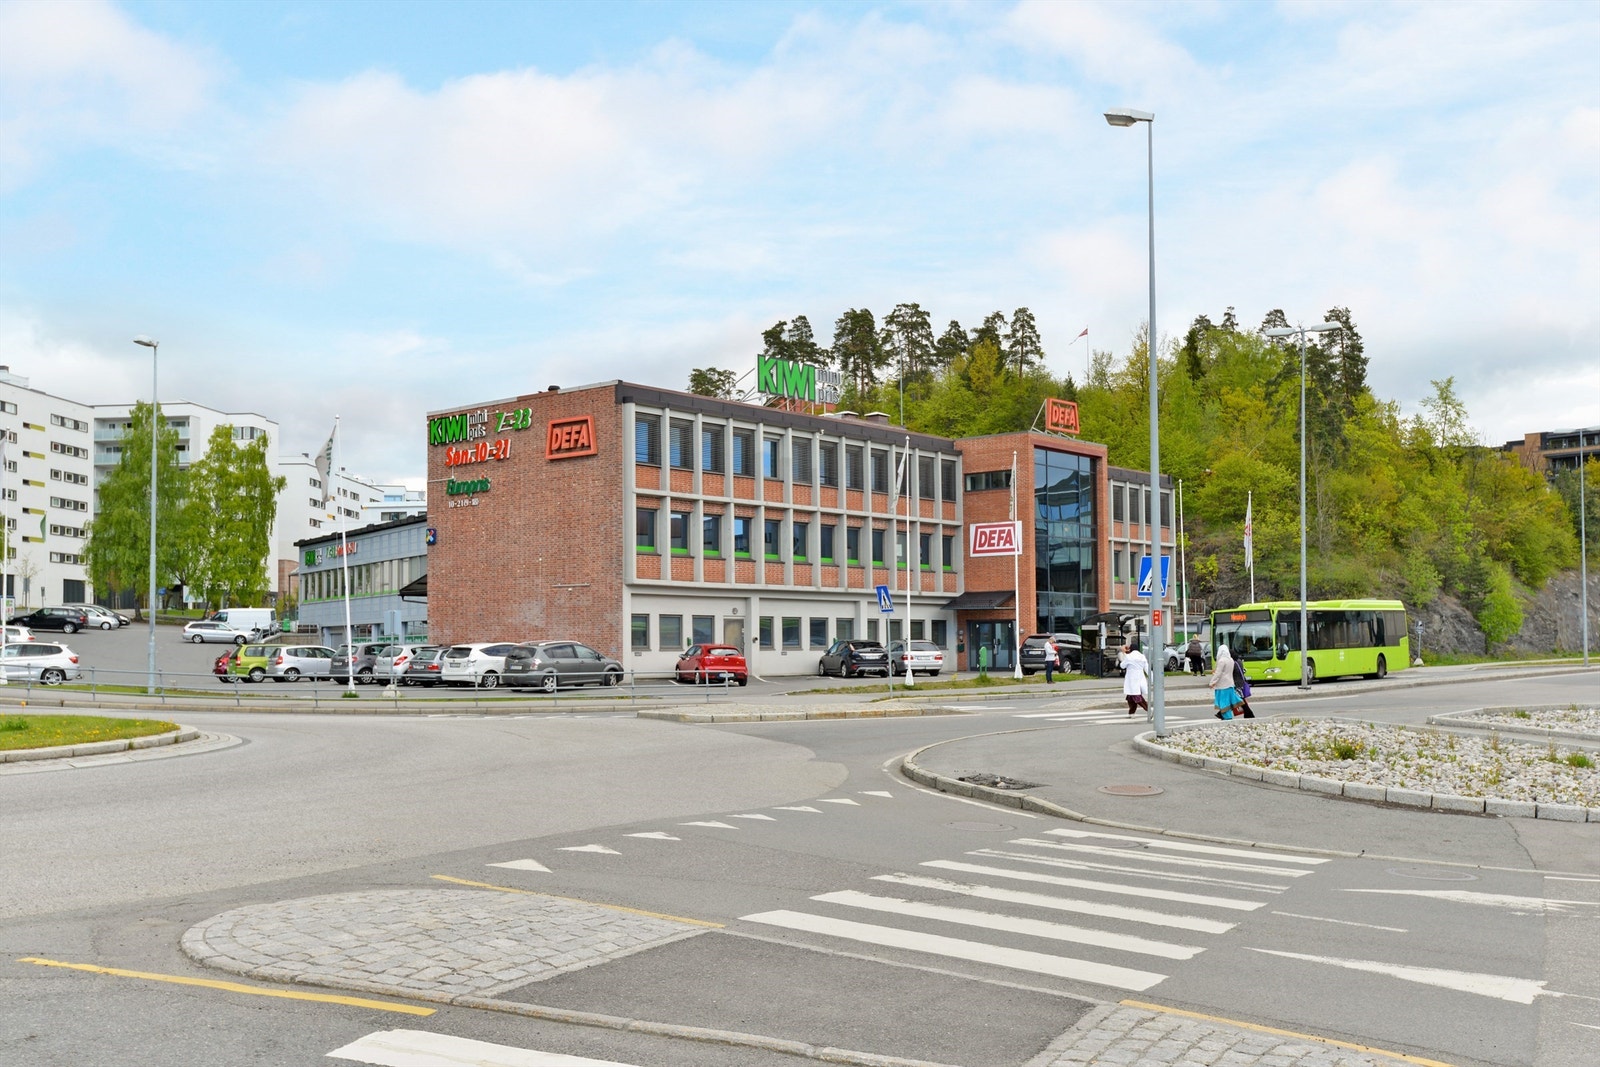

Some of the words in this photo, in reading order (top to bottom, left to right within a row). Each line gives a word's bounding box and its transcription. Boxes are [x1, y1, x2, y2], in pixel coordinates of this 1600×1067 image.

[758, 354, 816, 402] KIWI
[818, 386, 840, 404] pris
[469, 410, 487, 425] mini
[1053, 406, 1076, 426] DEFA
[429, 413, 468, 445] KIWI
[469, 425, 487, 441] pris
[551, 424, 590, 450] DEFA
[978, 529, 1013, 548] DEFA
